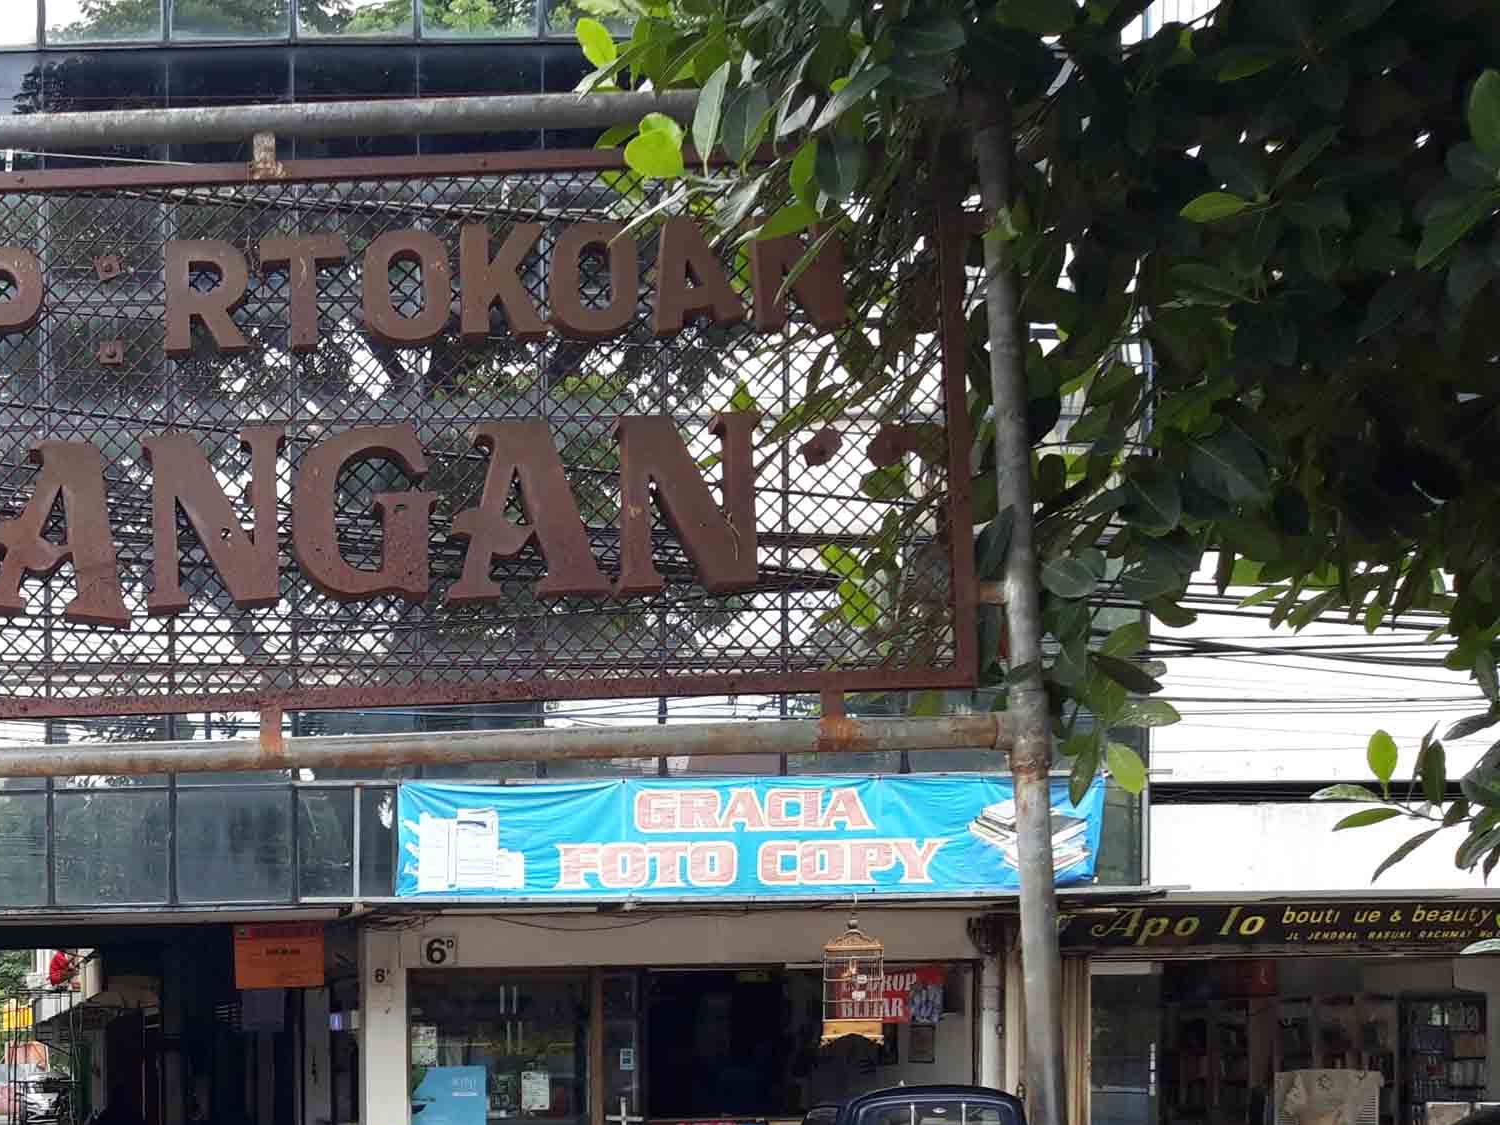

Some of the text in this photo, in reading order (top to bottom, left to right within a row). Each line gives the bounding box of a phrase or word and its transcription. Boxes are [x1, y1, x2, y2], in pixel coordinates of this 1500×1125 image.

[634, 788, 876, 832] GRACIA
[554, 838, 950, 888] FOTO COPY
[1412, 904, 1493, 927] beauty
